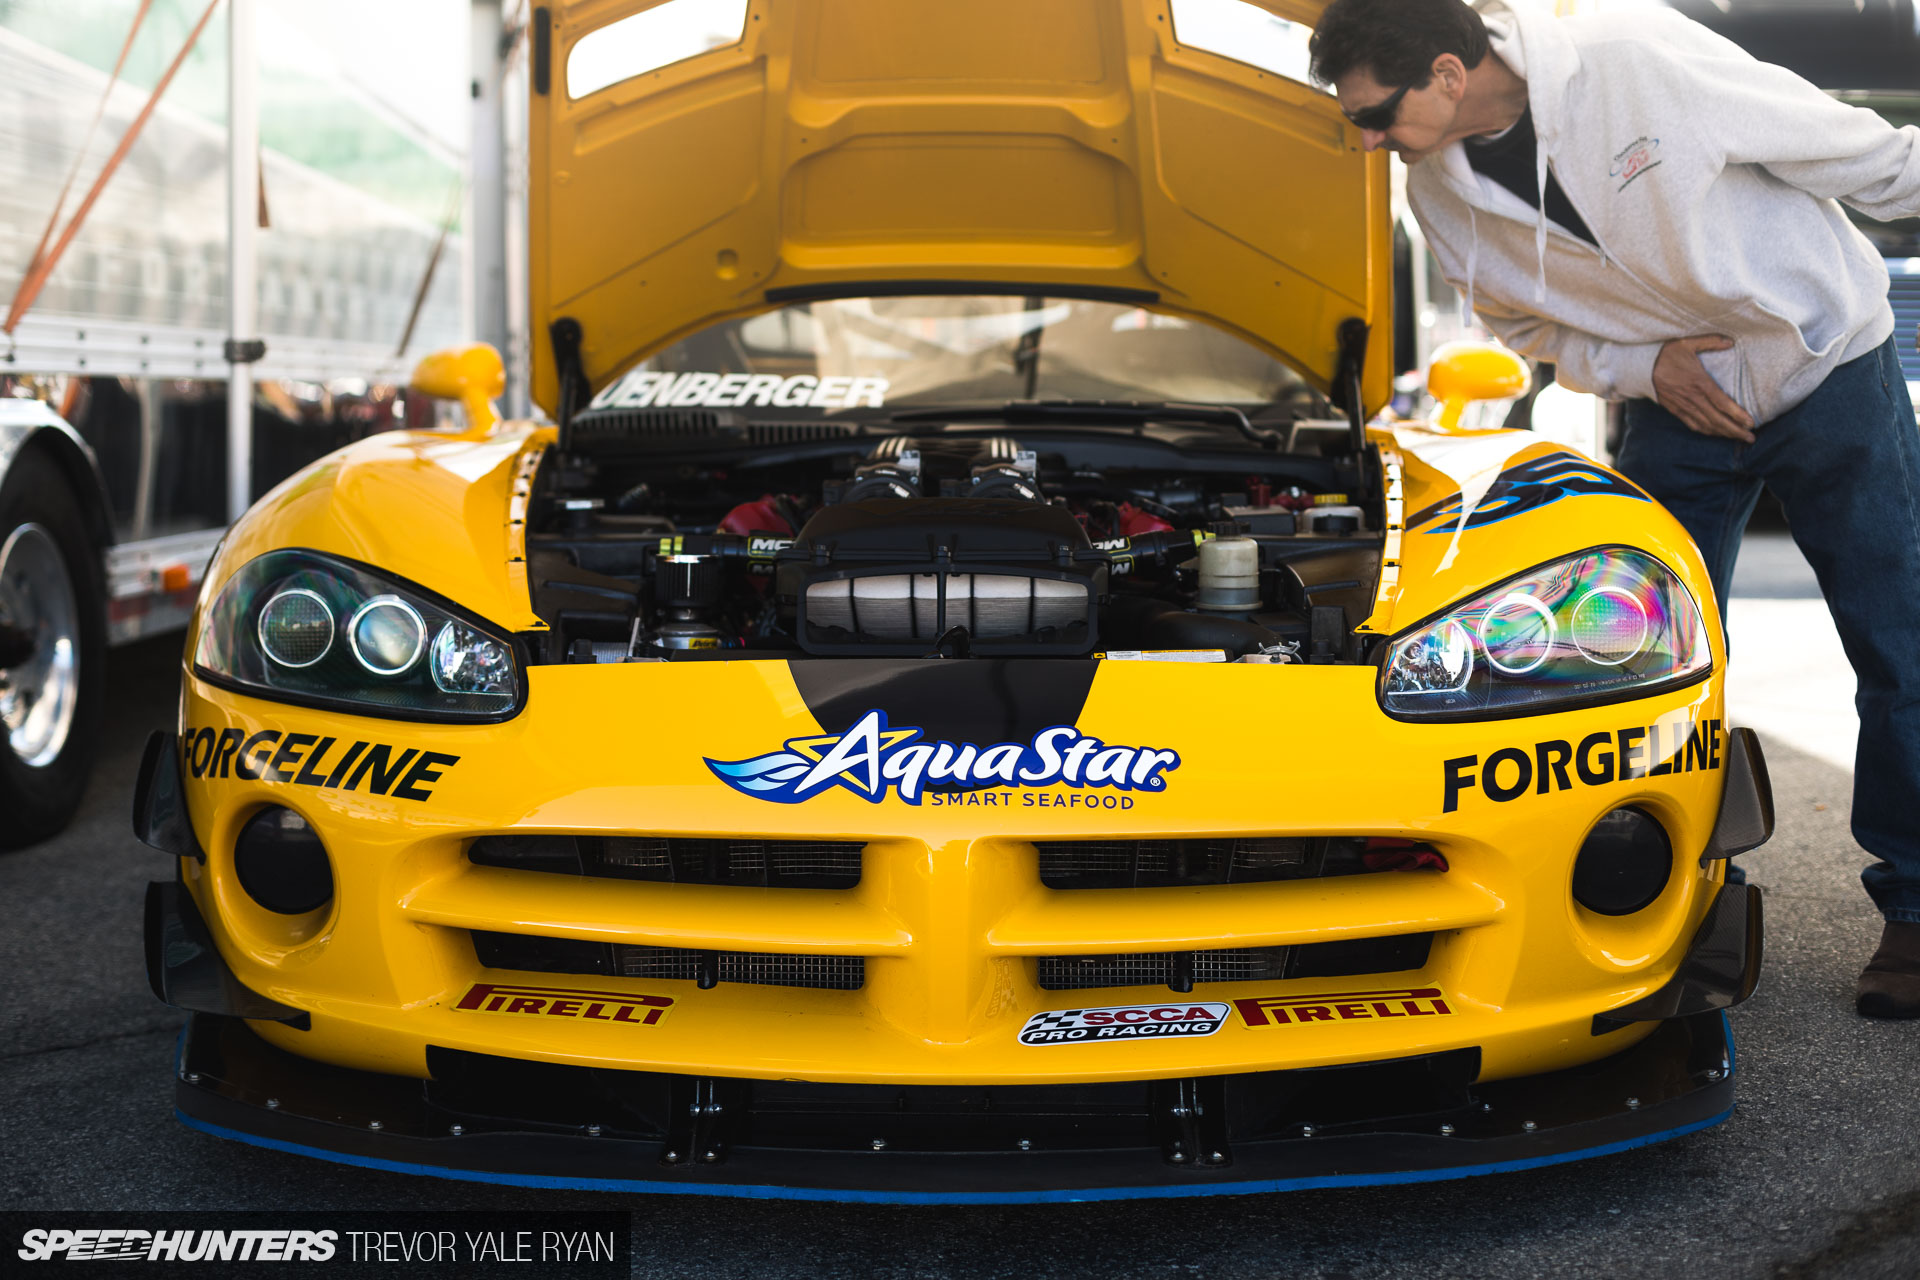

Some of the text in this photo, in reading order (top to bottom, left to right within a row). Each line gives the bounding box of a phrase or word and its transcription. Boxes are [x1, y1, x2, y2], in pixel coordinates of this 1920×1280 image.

[752, 538, 796, 550] MC
[184, 727, 461, 801] FORGELINE
[1442, 719, 1721, 813] FORGELINE
[931, 792, 1135, 810] SMART SEAFOOD
[456, 984, 674, 1026] PIRELLI
[1083, 1007, 1218, 1026] SCCA
[1233, 988, 1452, 1027] PIRELLI
[1027, 1022, 1213, 1043] PRO RACING
